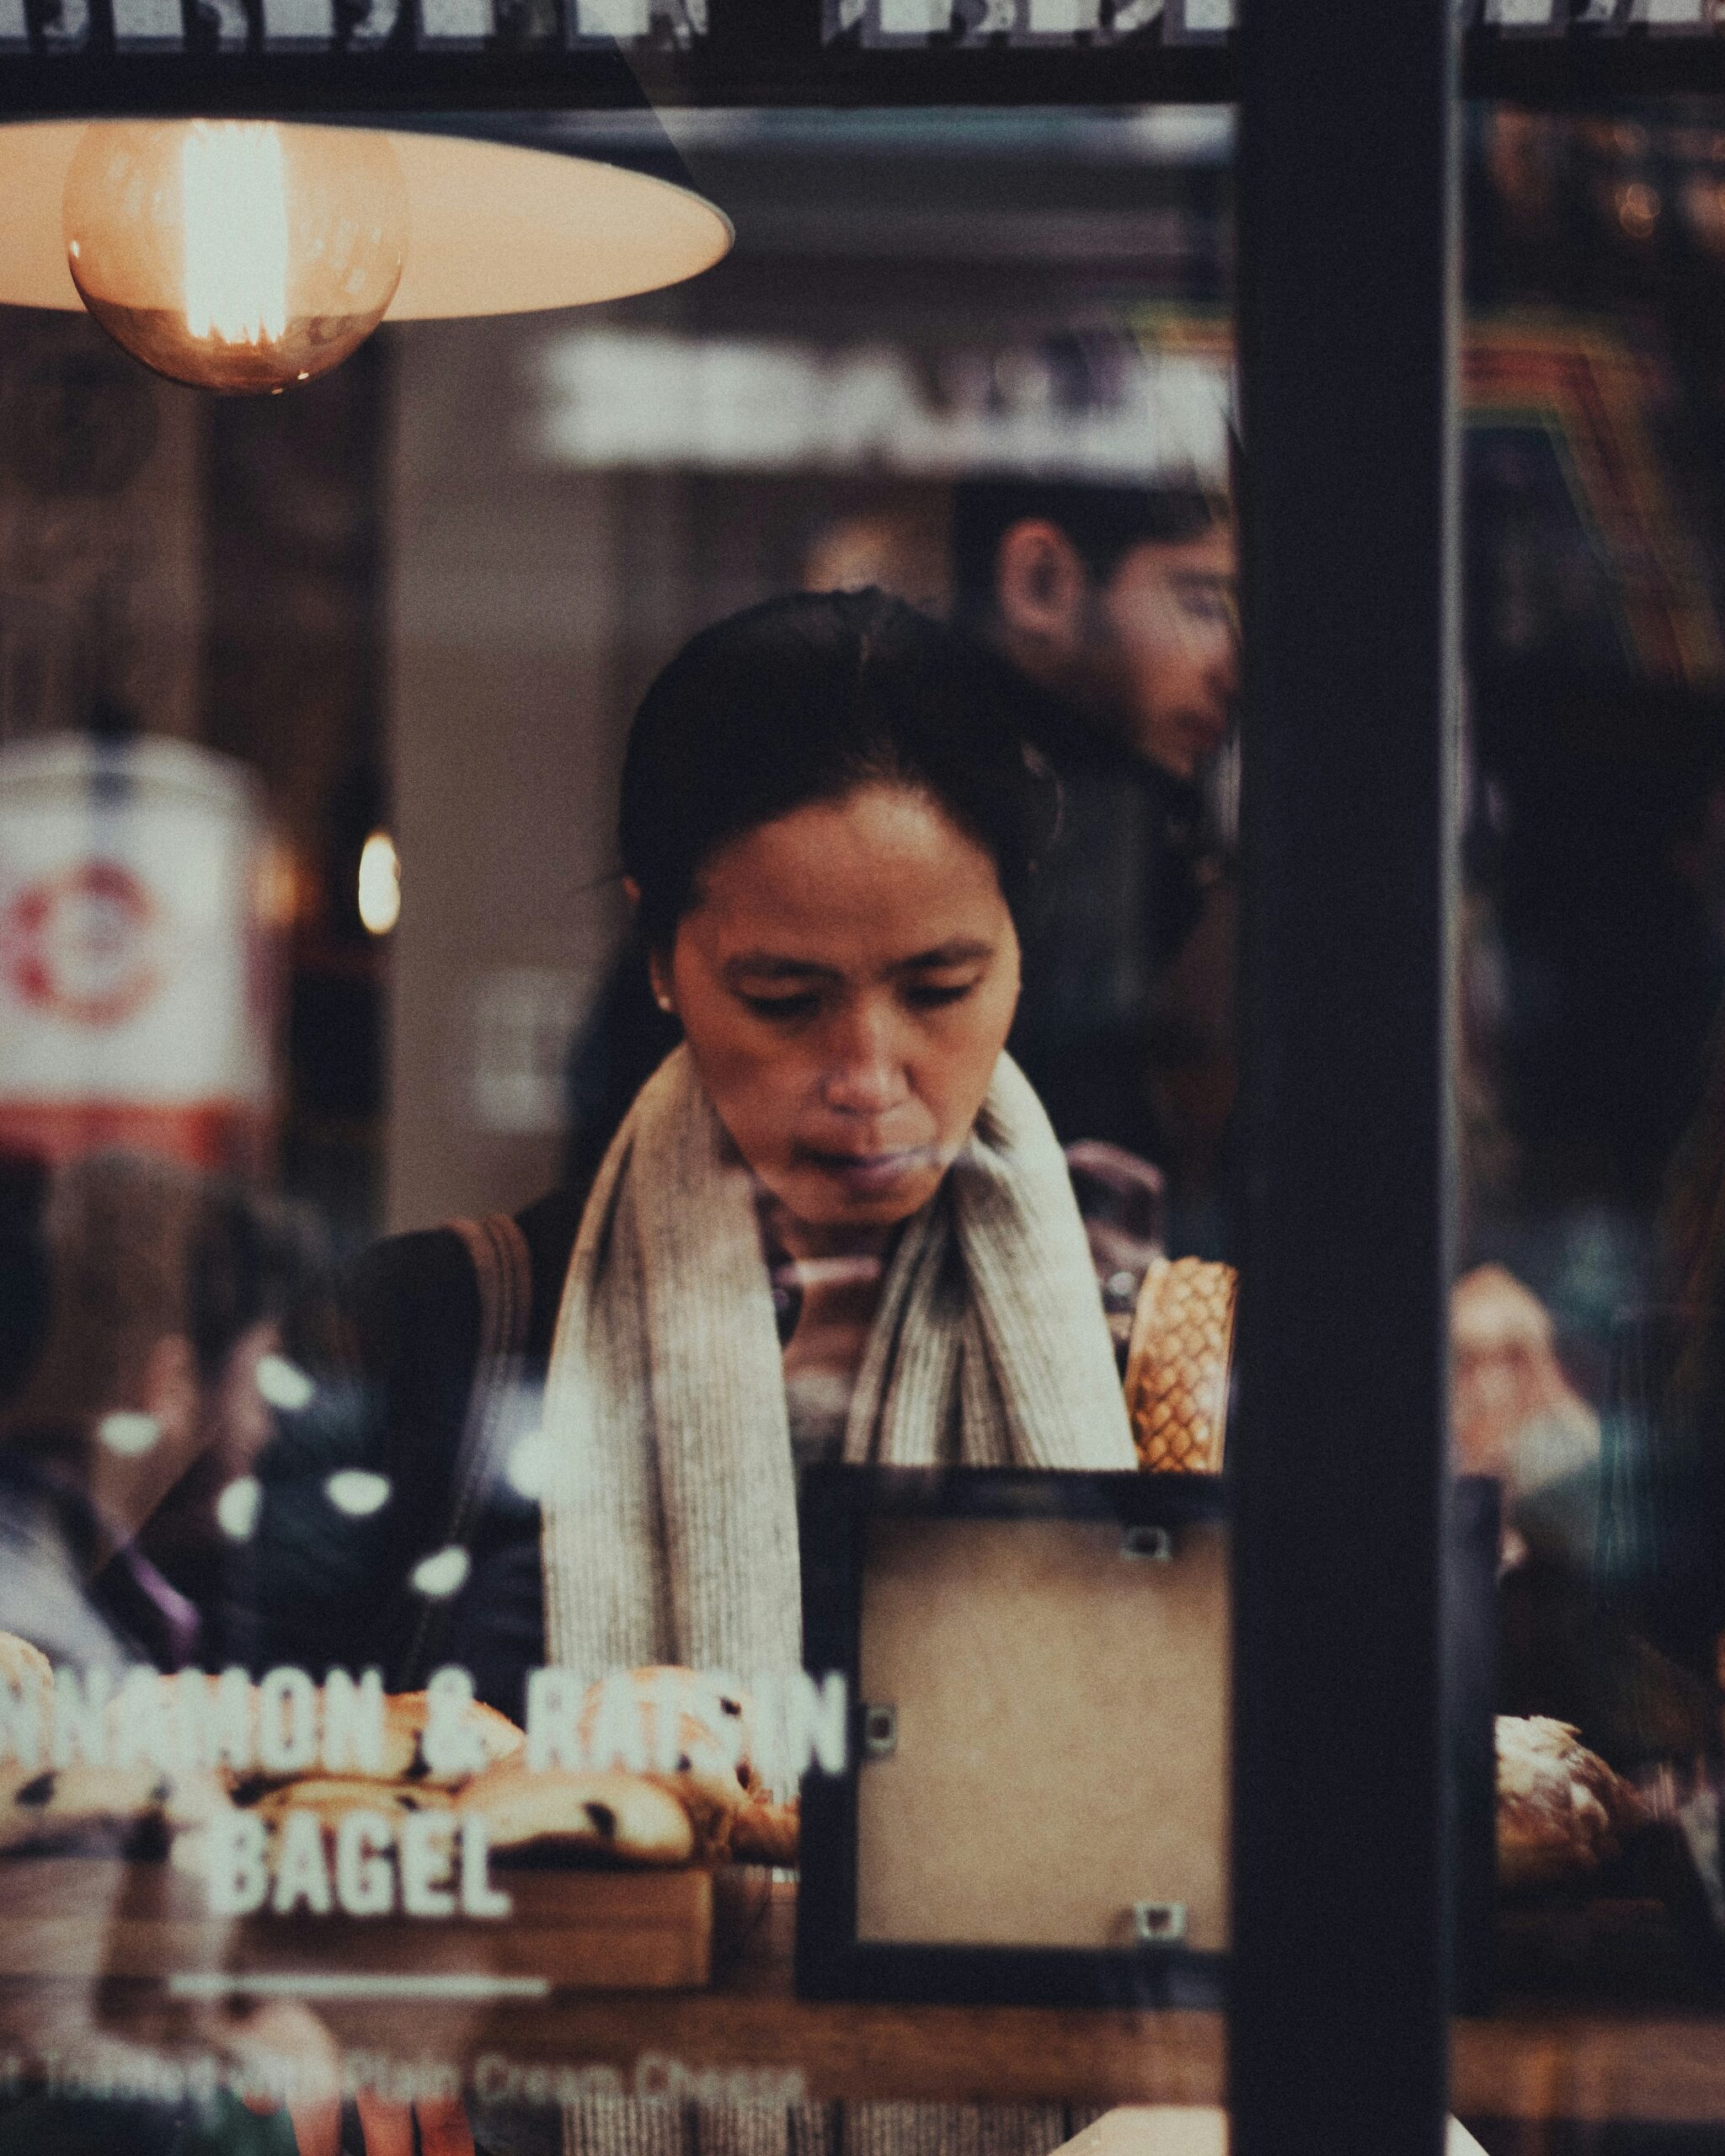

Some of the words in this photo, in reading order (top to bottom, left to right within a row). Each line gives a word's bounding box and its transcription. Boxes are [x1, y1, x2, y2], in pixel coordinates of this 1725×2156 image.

[421, 1664, 495, 1775] &
[526, 1665, 847, 1774] RAISIN
[207, 1808, 513, 1918] BAGEL
[342, 2048, 461, 2105] Plain
[473, 2052, 623, 2105] Cream
[634, 2052, 807, 2107] Cheese
